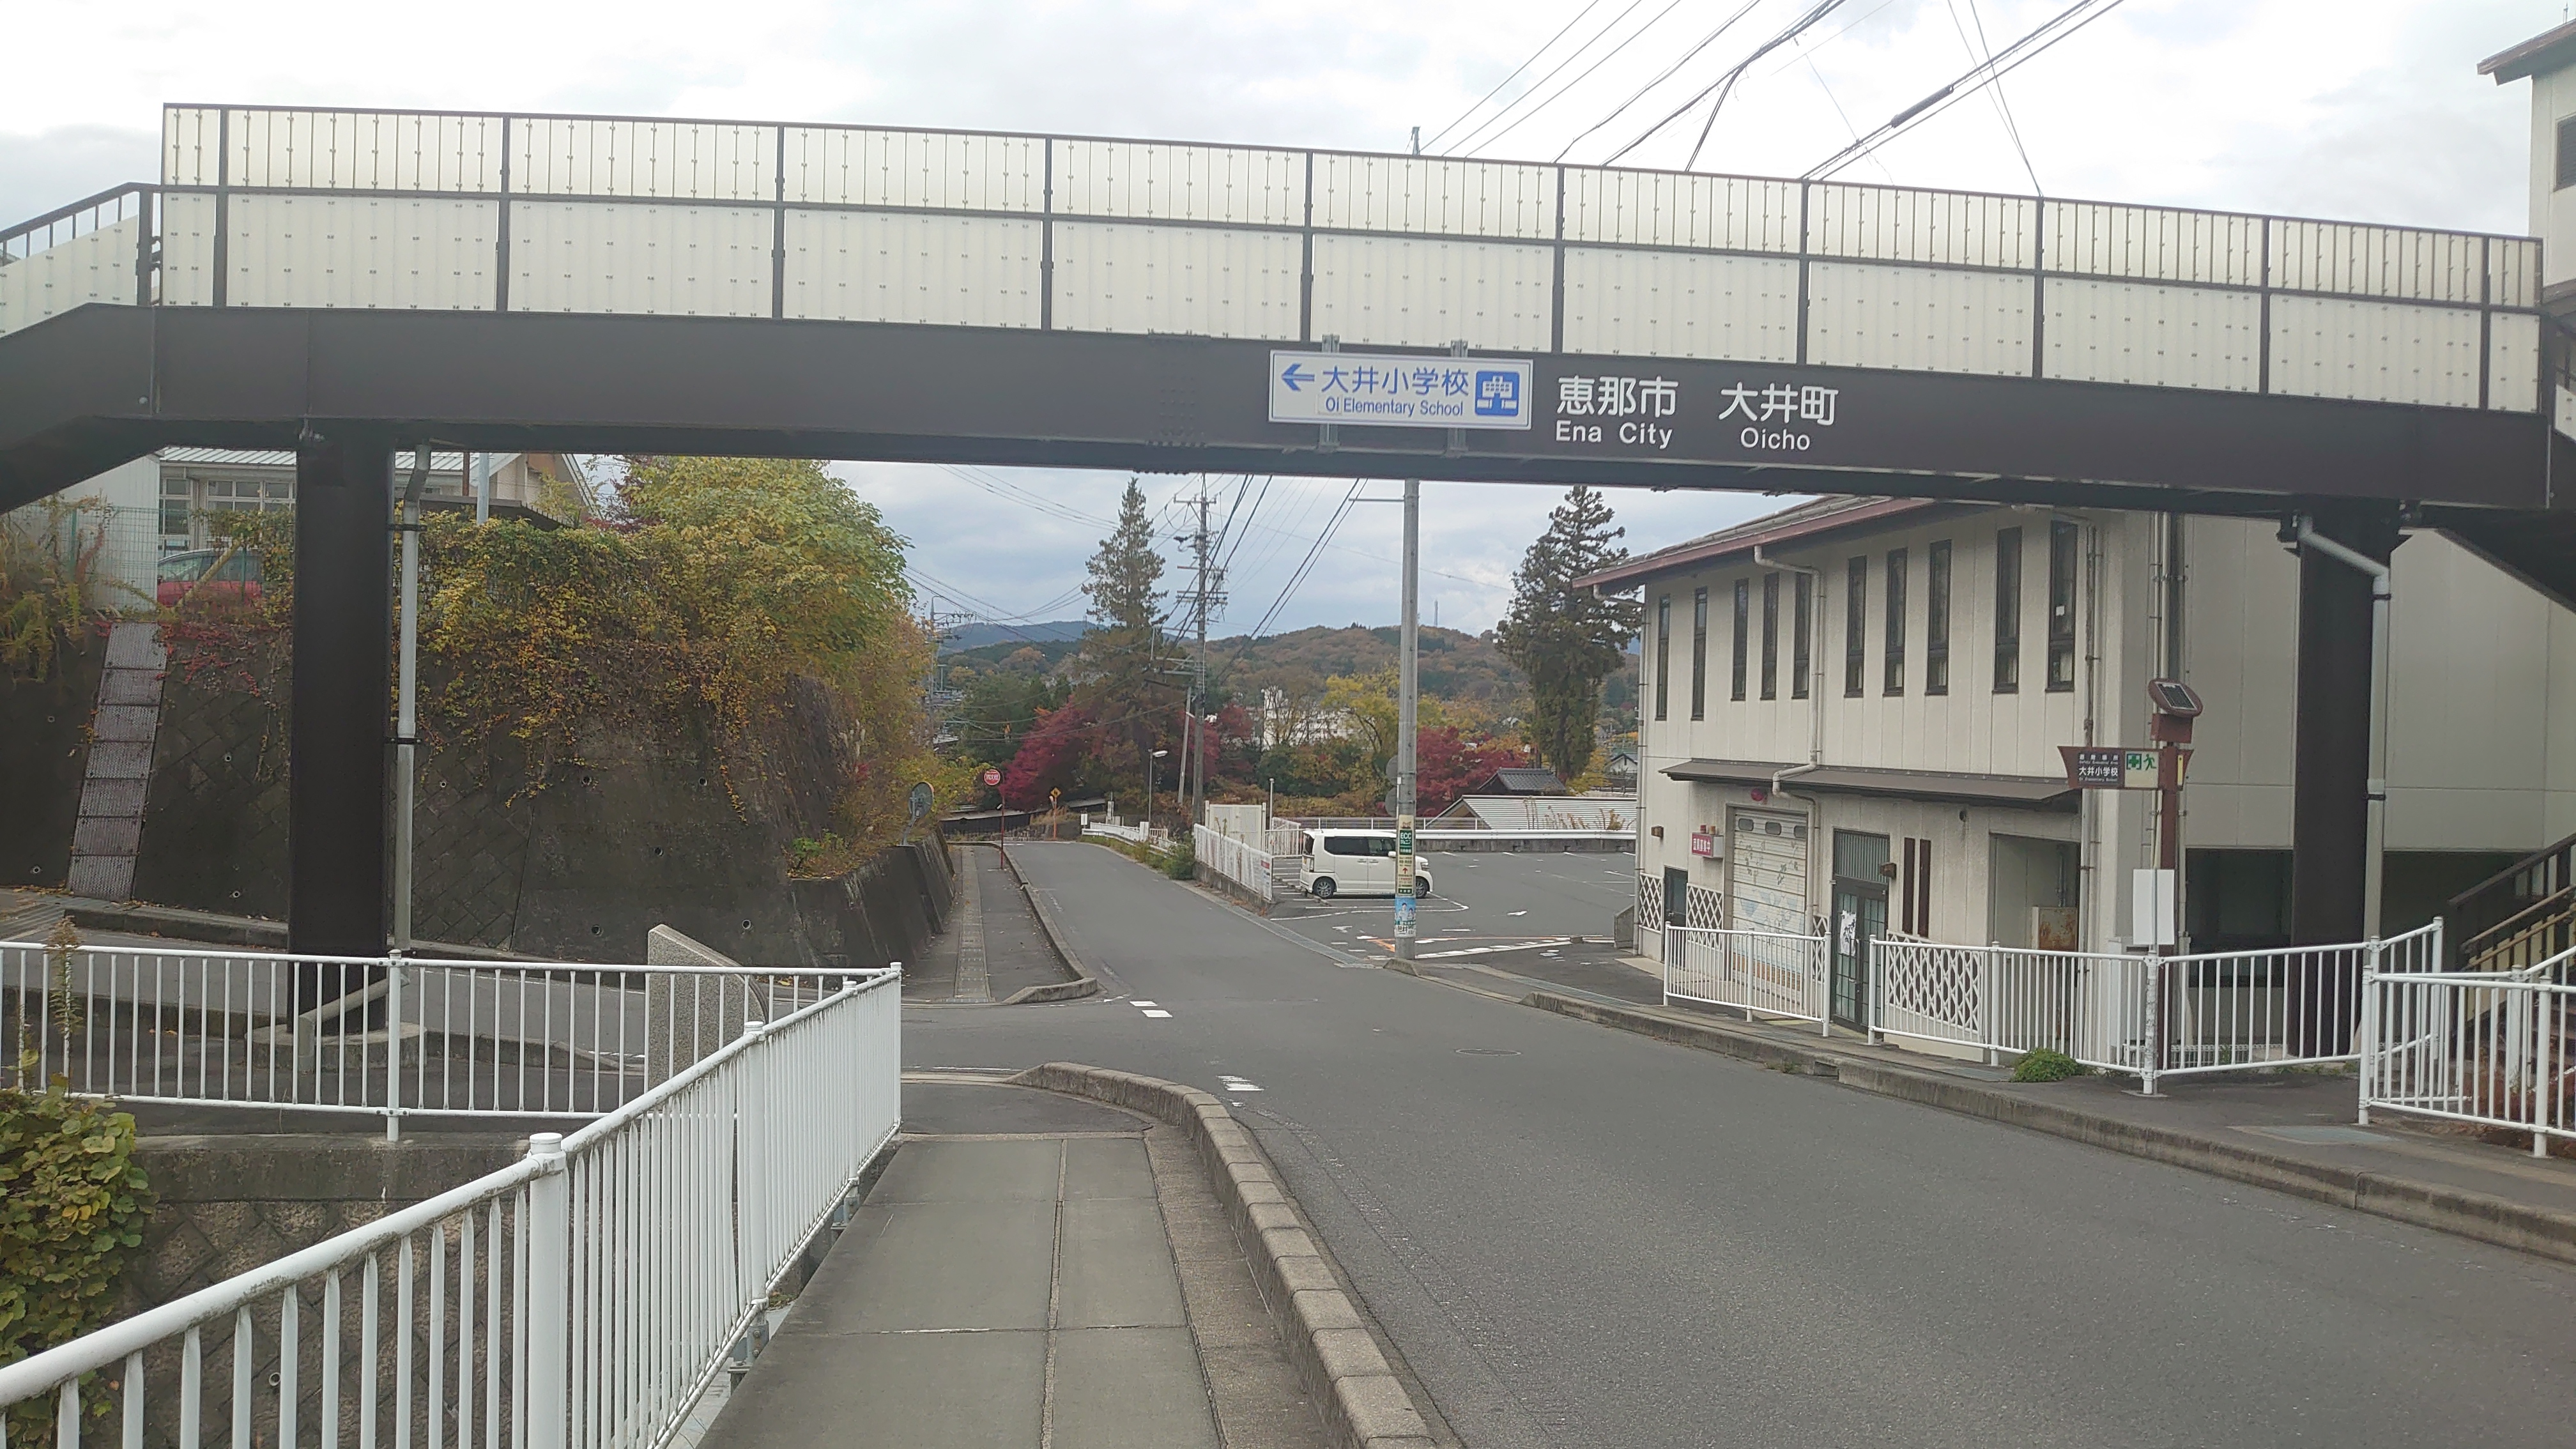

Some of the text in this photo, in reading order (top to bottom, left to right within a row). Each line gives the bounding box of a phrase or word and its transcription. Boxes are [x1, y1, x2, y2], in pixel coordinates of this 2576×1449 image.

[1321, 365, 1469, 397] 大井小学校
[1556, 374, 1679, 418] 恵那市
[1343, 397, 1415, 417] Elementary
[1420, 399, 1464, 416] School
[1718, 381, 1839, 425] 大井町
[1555, 419, 1673, 450] Ena City
[1740, 426, 1811, 450] Oicho
[2079, 766, 2118, 776] 大井小学校
